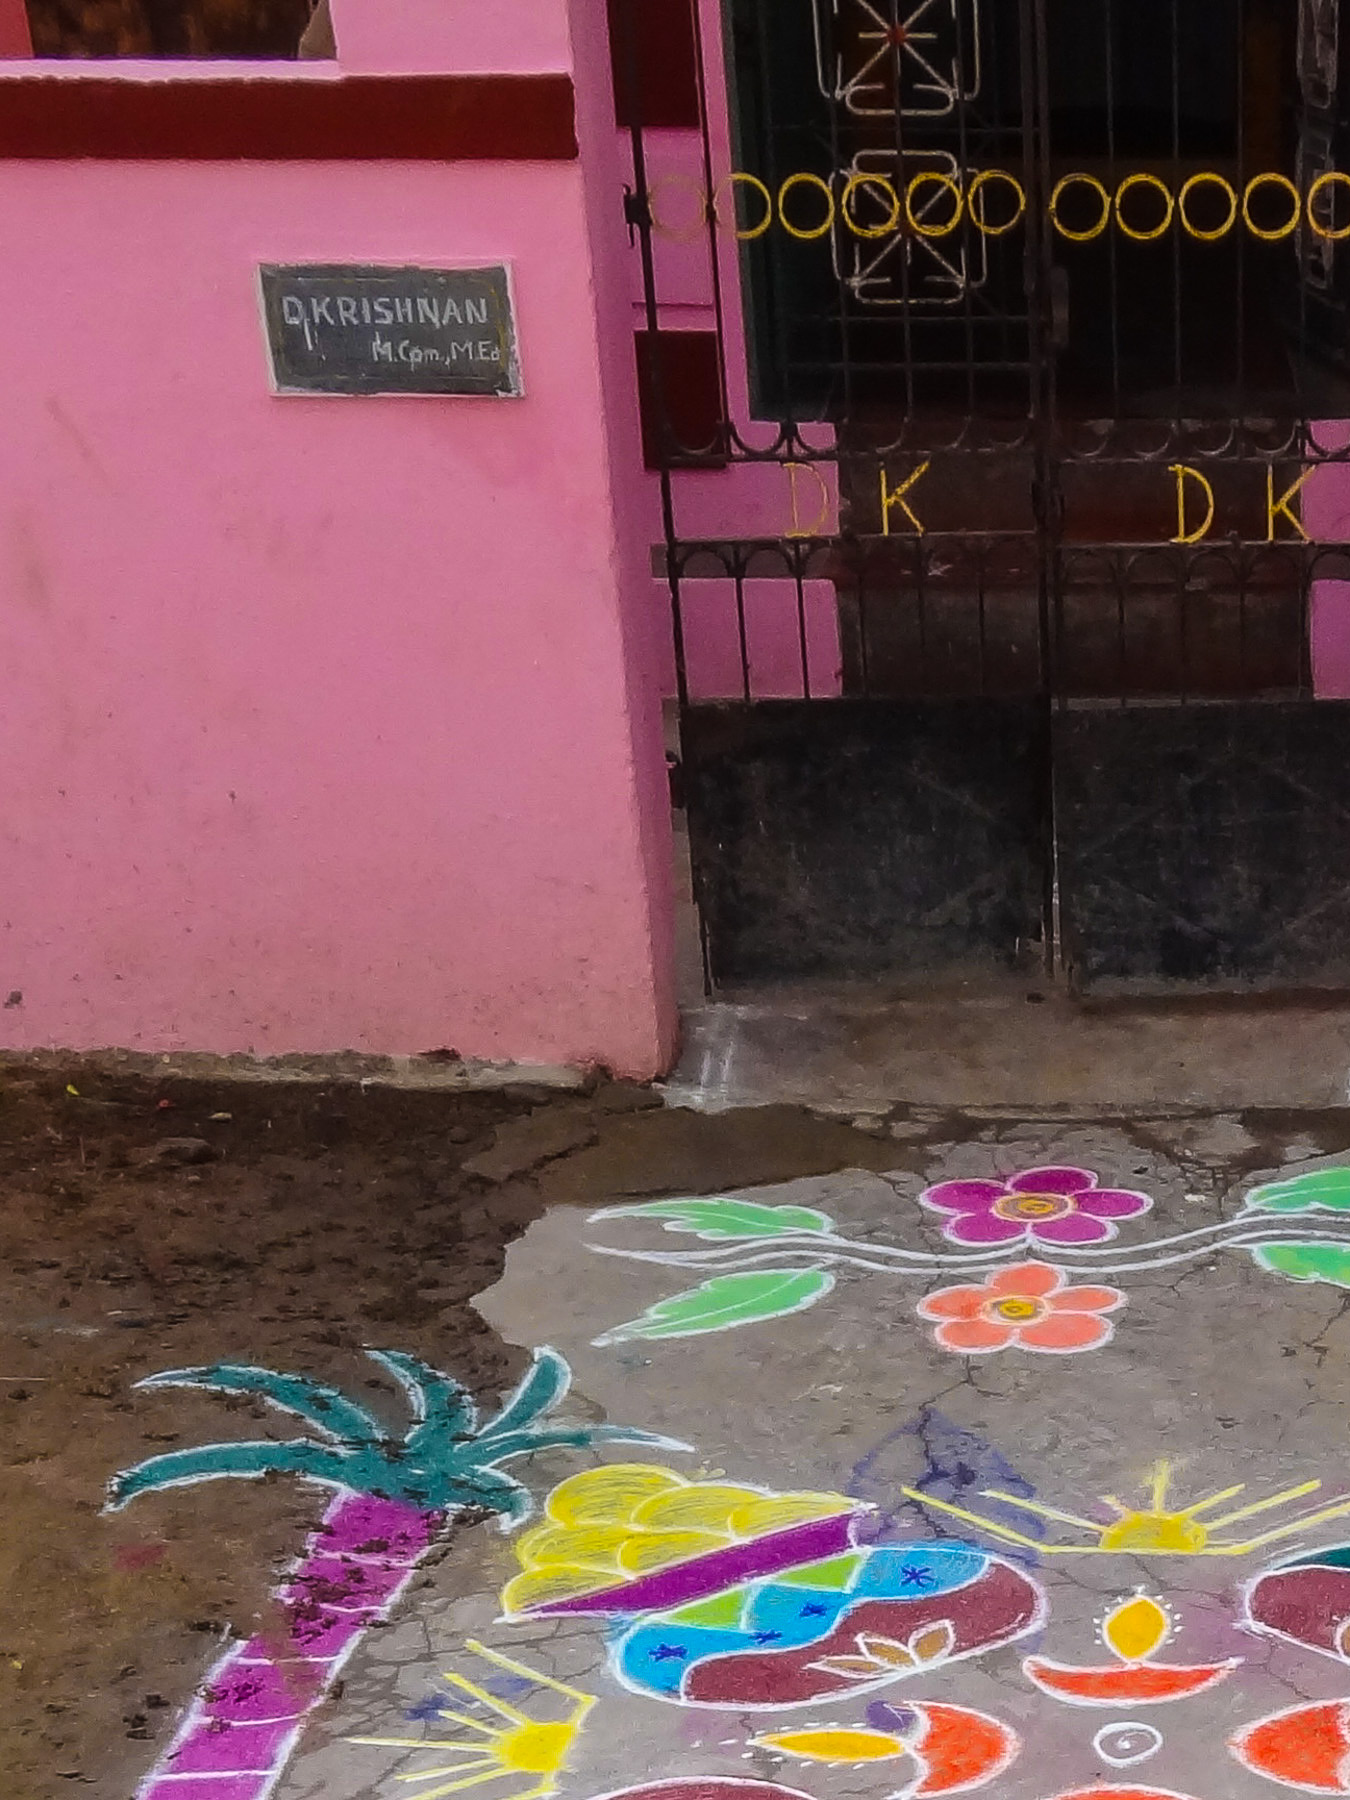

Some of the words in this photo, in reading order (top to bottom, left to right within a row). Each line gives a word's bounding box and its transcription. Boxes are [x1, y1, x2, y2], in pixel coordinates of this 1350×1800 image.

[878, 460, 930, 537] K
[1167, 464, 1215, 545] D
[1267, 463, 1318, 543] K
